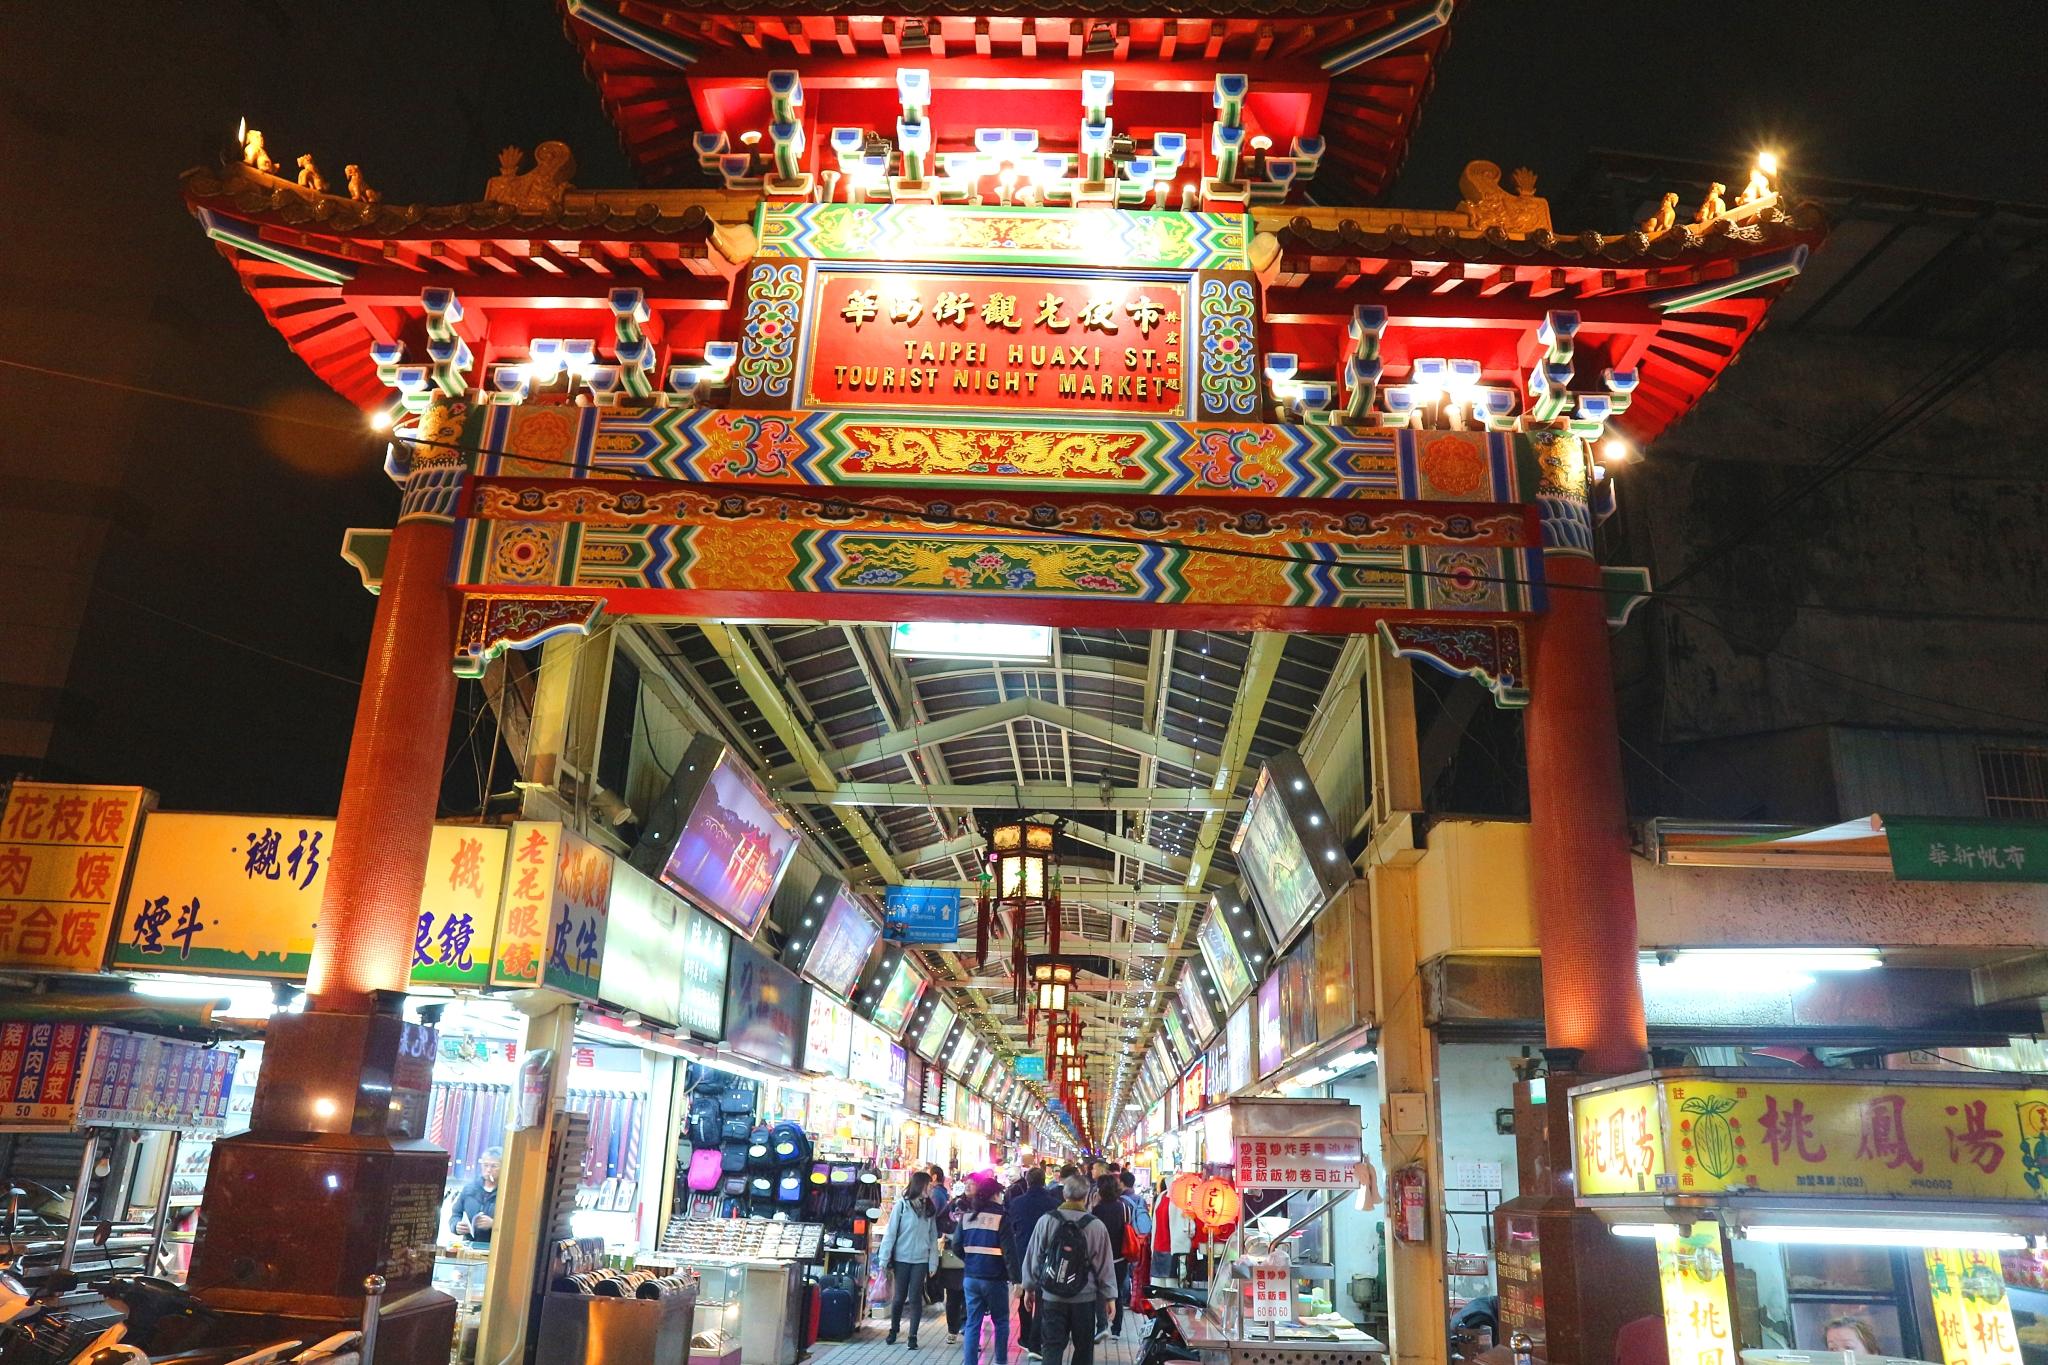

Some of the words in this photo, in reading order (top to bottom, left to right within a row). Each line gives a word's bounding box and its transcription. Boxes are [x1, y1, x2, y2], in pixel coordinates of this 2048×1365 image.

[905, 339, 987, 364] TAIPEI
[1009, 344, 1101, 369] HUAXI
[1124, 346, 1162, 370] ST.
[834, 365, 939, 390] TOURIST
[953, 371, 1038, 394] NIGHT
[1058, 373, 1166, 400] MARKET
[244, 827, 321, 890] 襯衫
[1929, 843, 2025, 870] 華新帆布
[502, 829, 549, 979] 老花眼鏡
[132, 895, 204, 960] 煙斗
[551, 903, 599, 990] 皮件
[15, 1105, 31, 1117] 50
[41, 1106, 57, 1118] 30
[1758, 1094, 2006, 1175] 桃鳳湯
[1205, 1187, 1218, 1218] さしみ
